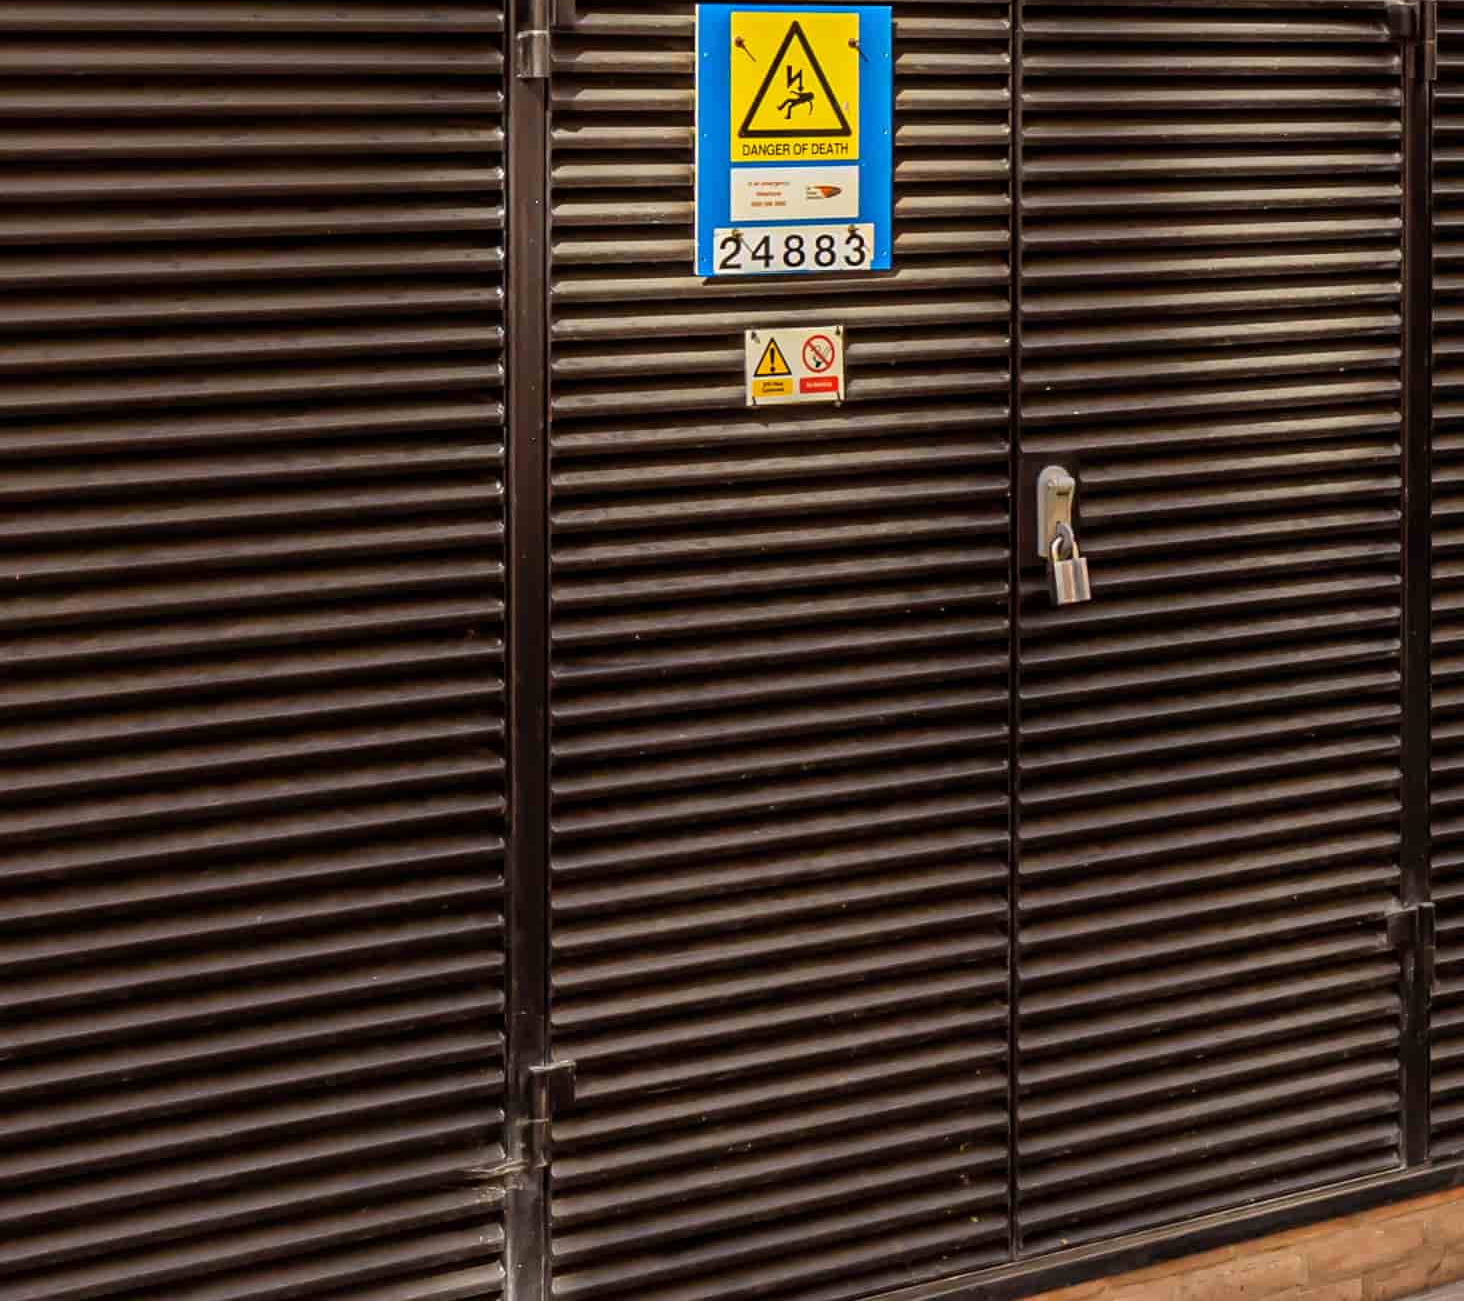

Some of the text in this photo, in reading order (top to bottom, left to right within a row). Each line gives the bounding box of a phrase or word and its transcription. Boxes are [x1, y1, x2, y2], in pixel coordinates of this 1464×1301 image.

[742, 142, 848, 156] DANGER OF DEATH
[719, 234, 866, 270] 24883
